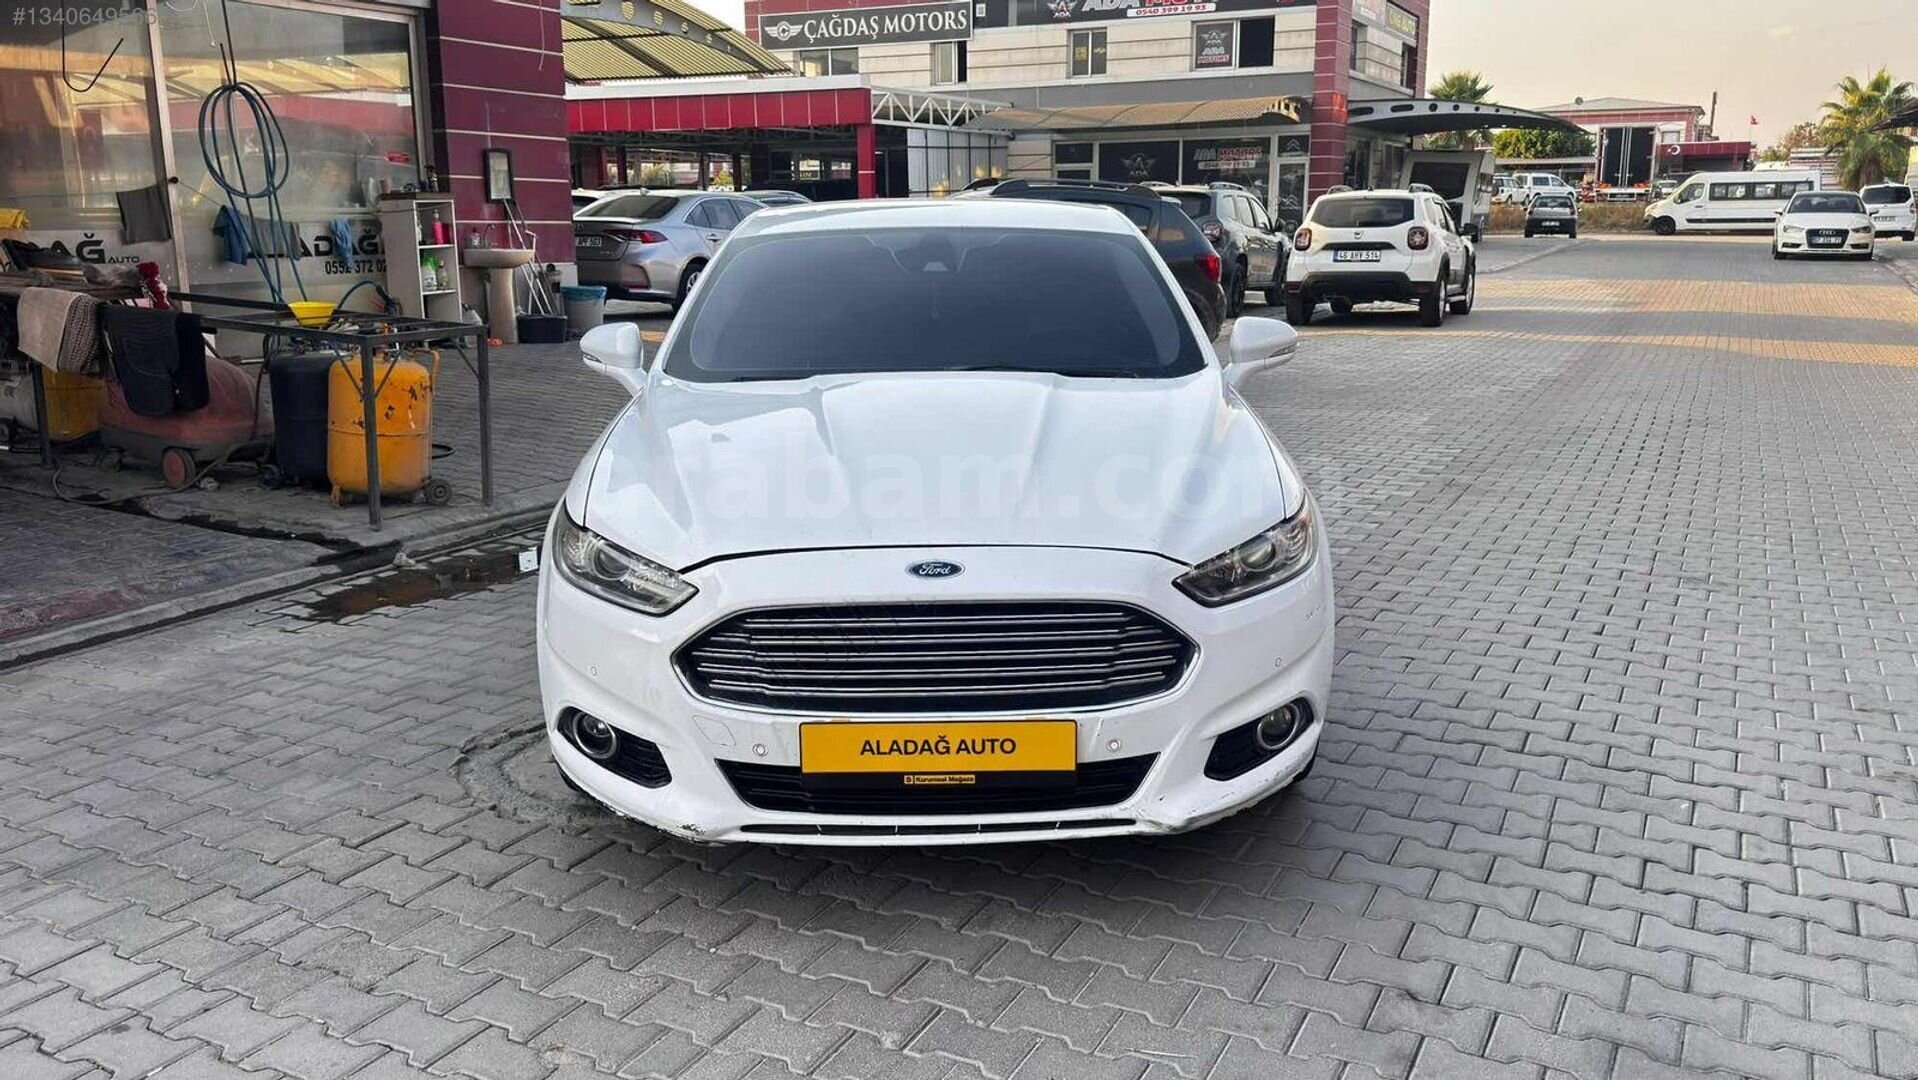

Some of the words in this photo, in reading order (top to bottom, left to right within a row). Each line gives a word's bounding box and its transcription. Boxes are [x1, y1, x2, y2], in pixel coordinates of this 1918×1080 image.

[803, 13, 879, 43] ÇAĞDAŞ
[883, 9, 967, 34] MOTORS
[108, 256, 141, 264] AUTO
[354, 259, 374, 274] 372
[919, 563, 952, 575] Ford
[860, 735, 951, 756] ALADAĞ
[955, 738, 1017, 755] AUTO
